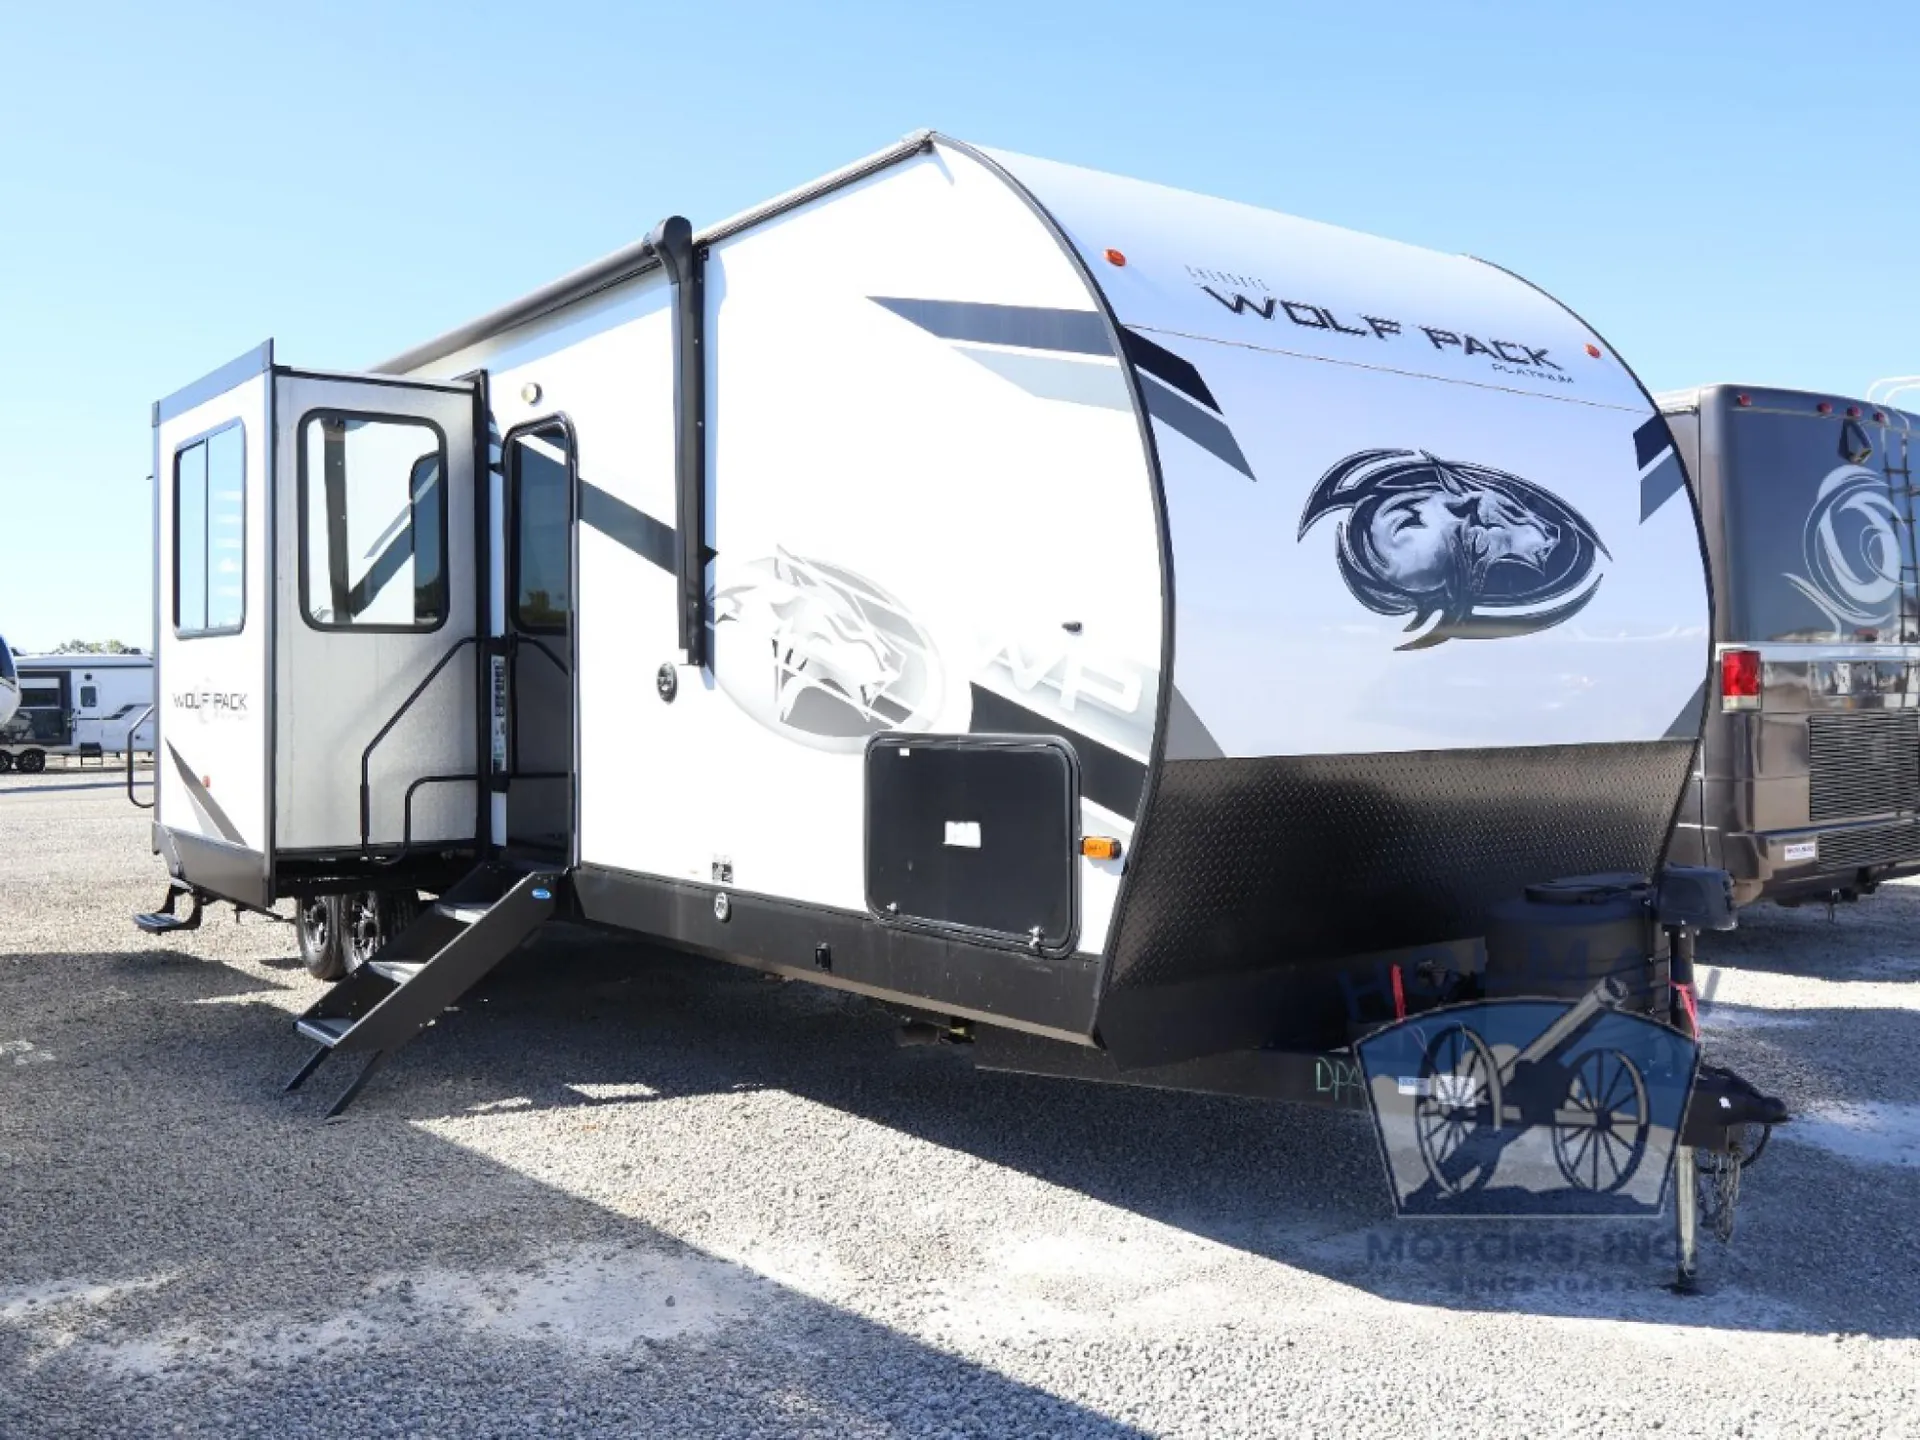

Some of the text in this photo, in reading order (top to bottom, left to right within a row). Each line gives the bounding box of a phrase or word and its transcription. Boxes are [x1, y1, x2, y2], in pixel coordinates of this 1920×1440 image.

[1201, 285, 1564, 370] WOLF PACK
[171, 692, 248, 711] WOLF PACK
